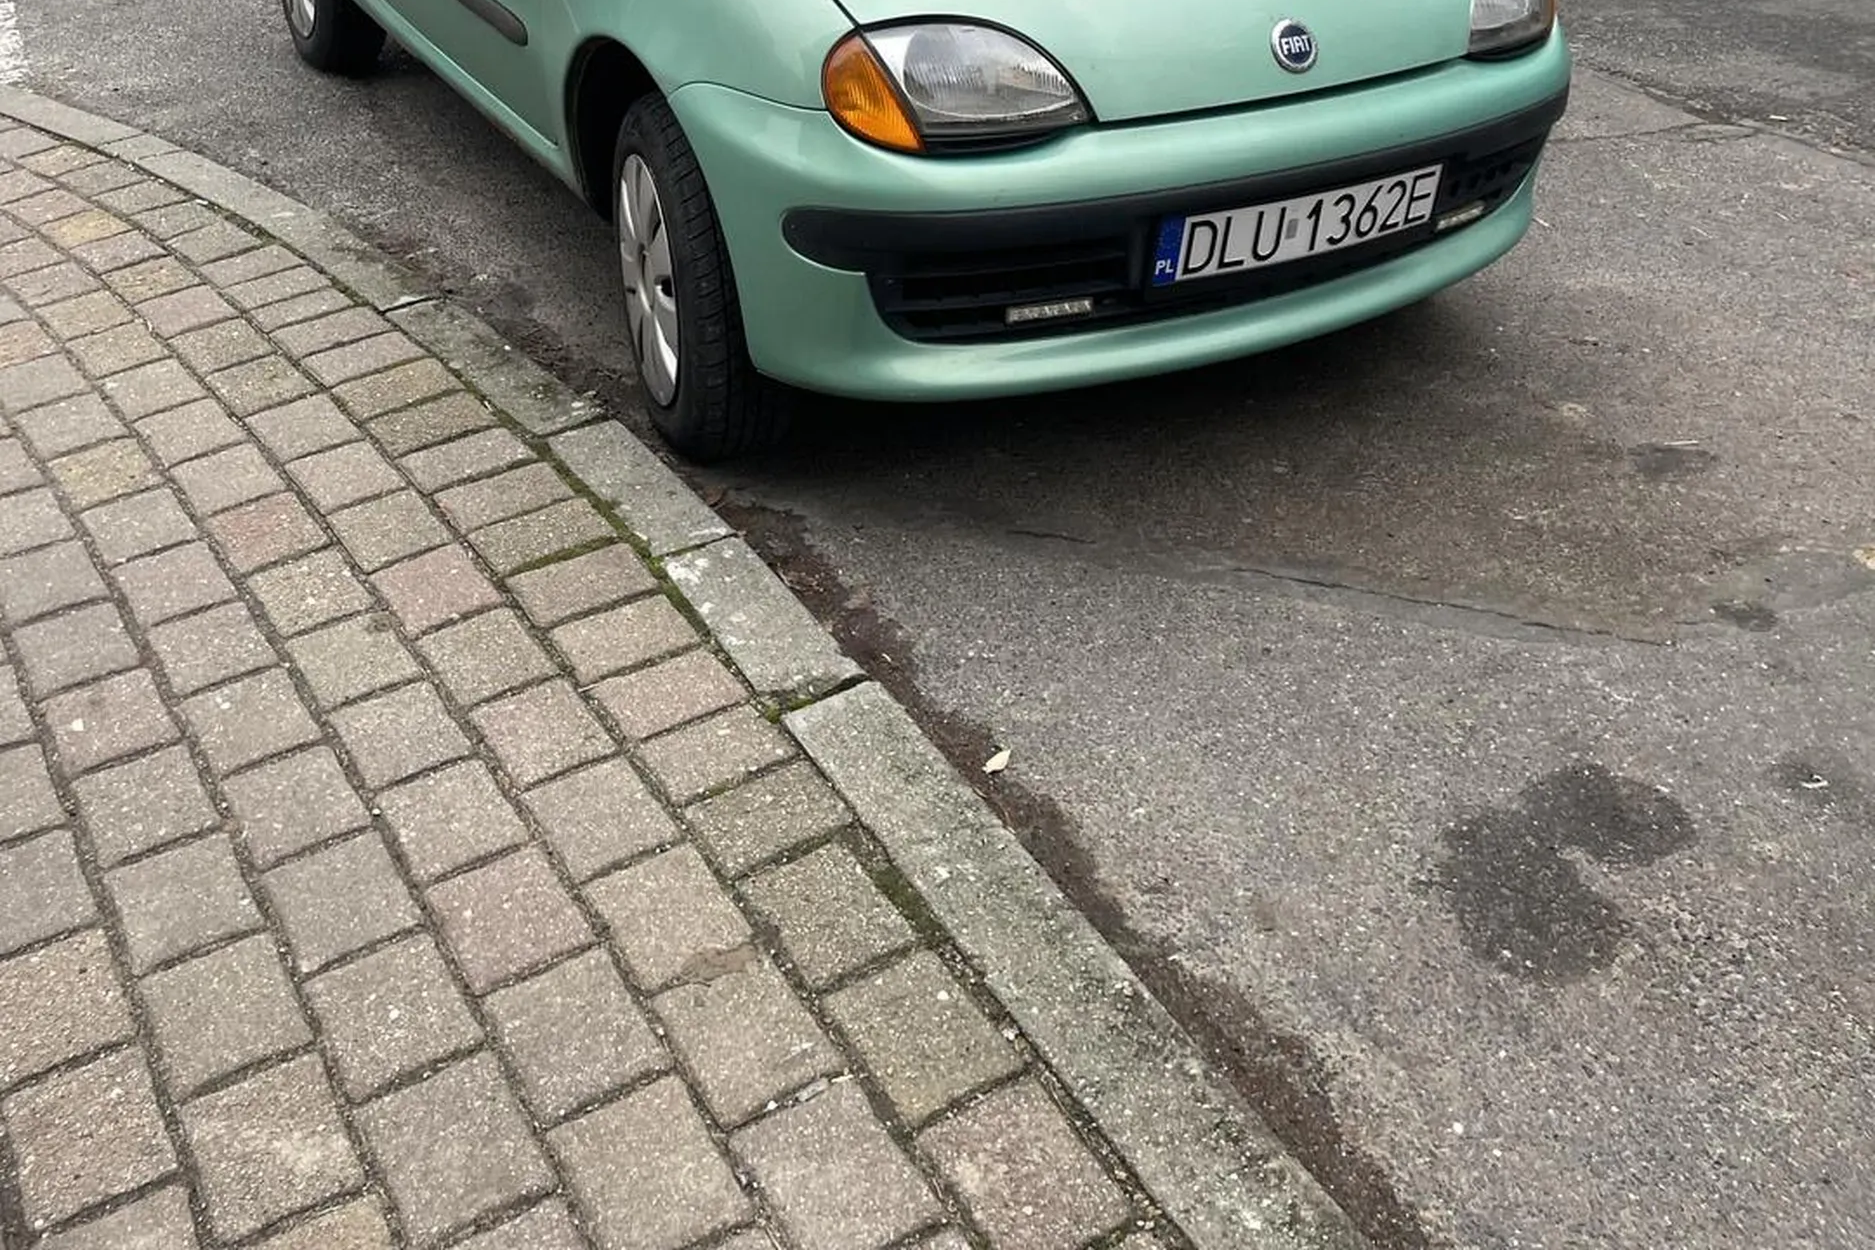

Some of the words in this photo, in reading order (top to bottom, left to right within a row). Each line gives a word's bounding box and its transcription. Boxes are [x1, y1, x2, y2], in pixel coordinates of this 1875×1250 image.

[1280, 35, 1311, 55] FIAT
[1182, 206, 1287, 276] DLU
[1306, 170, 1437, 252] 1362E
[1154, 258, 1175, 276] PL
